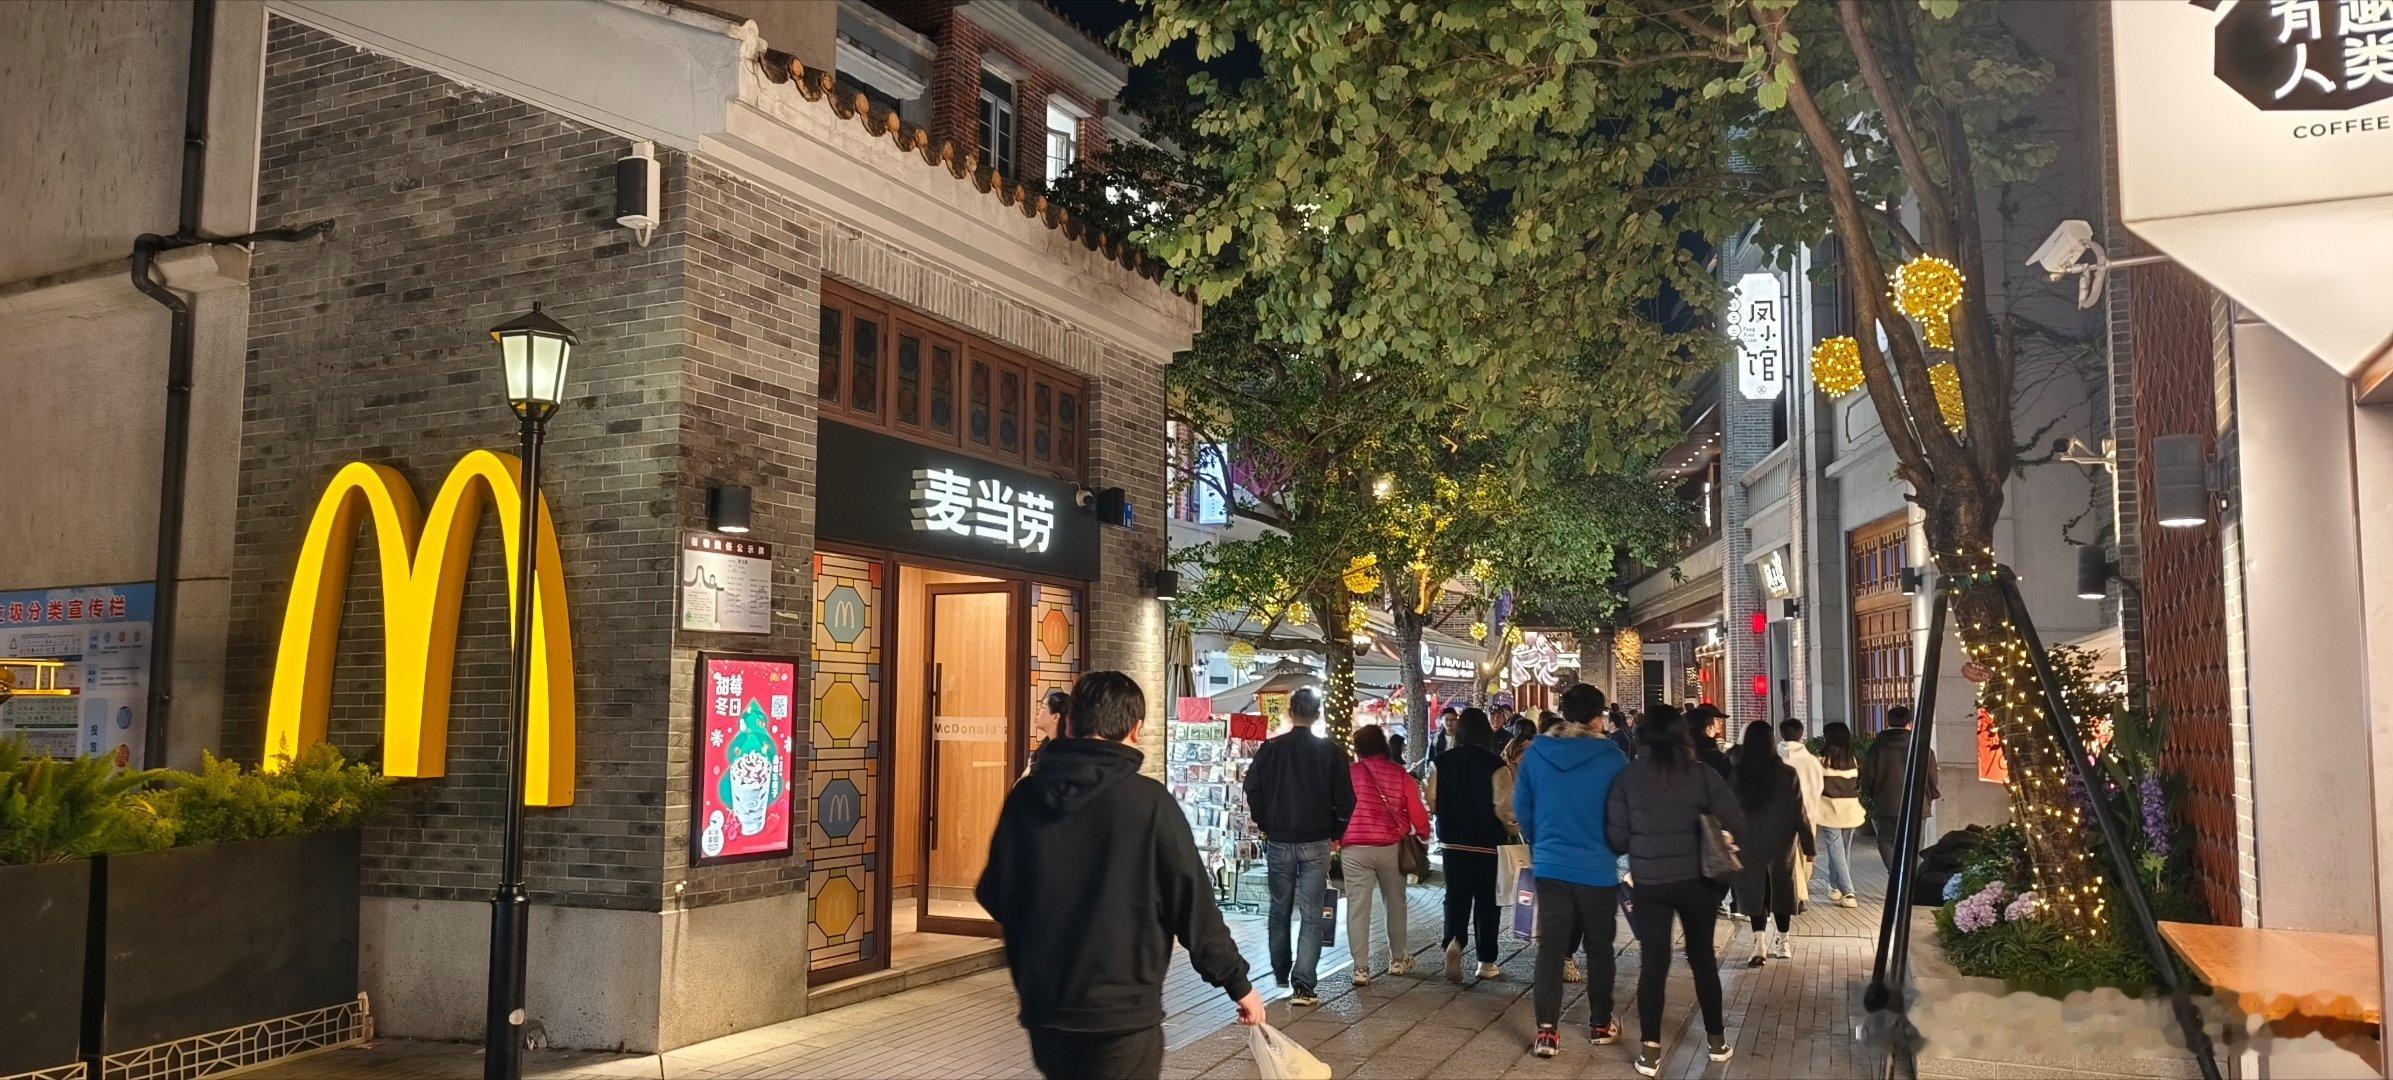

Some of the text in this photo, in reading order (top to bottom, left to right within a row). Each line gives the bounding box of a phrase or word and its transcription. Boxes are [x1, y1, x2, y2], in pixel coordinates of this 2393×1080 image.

[2275, 34, 2393, 100] 人类
[2293, 115, 2390, 139] COFFEE
[1747, 300, 1777, 382] 凤小馆
[922, 468, 1054, 553] 麦当劳
